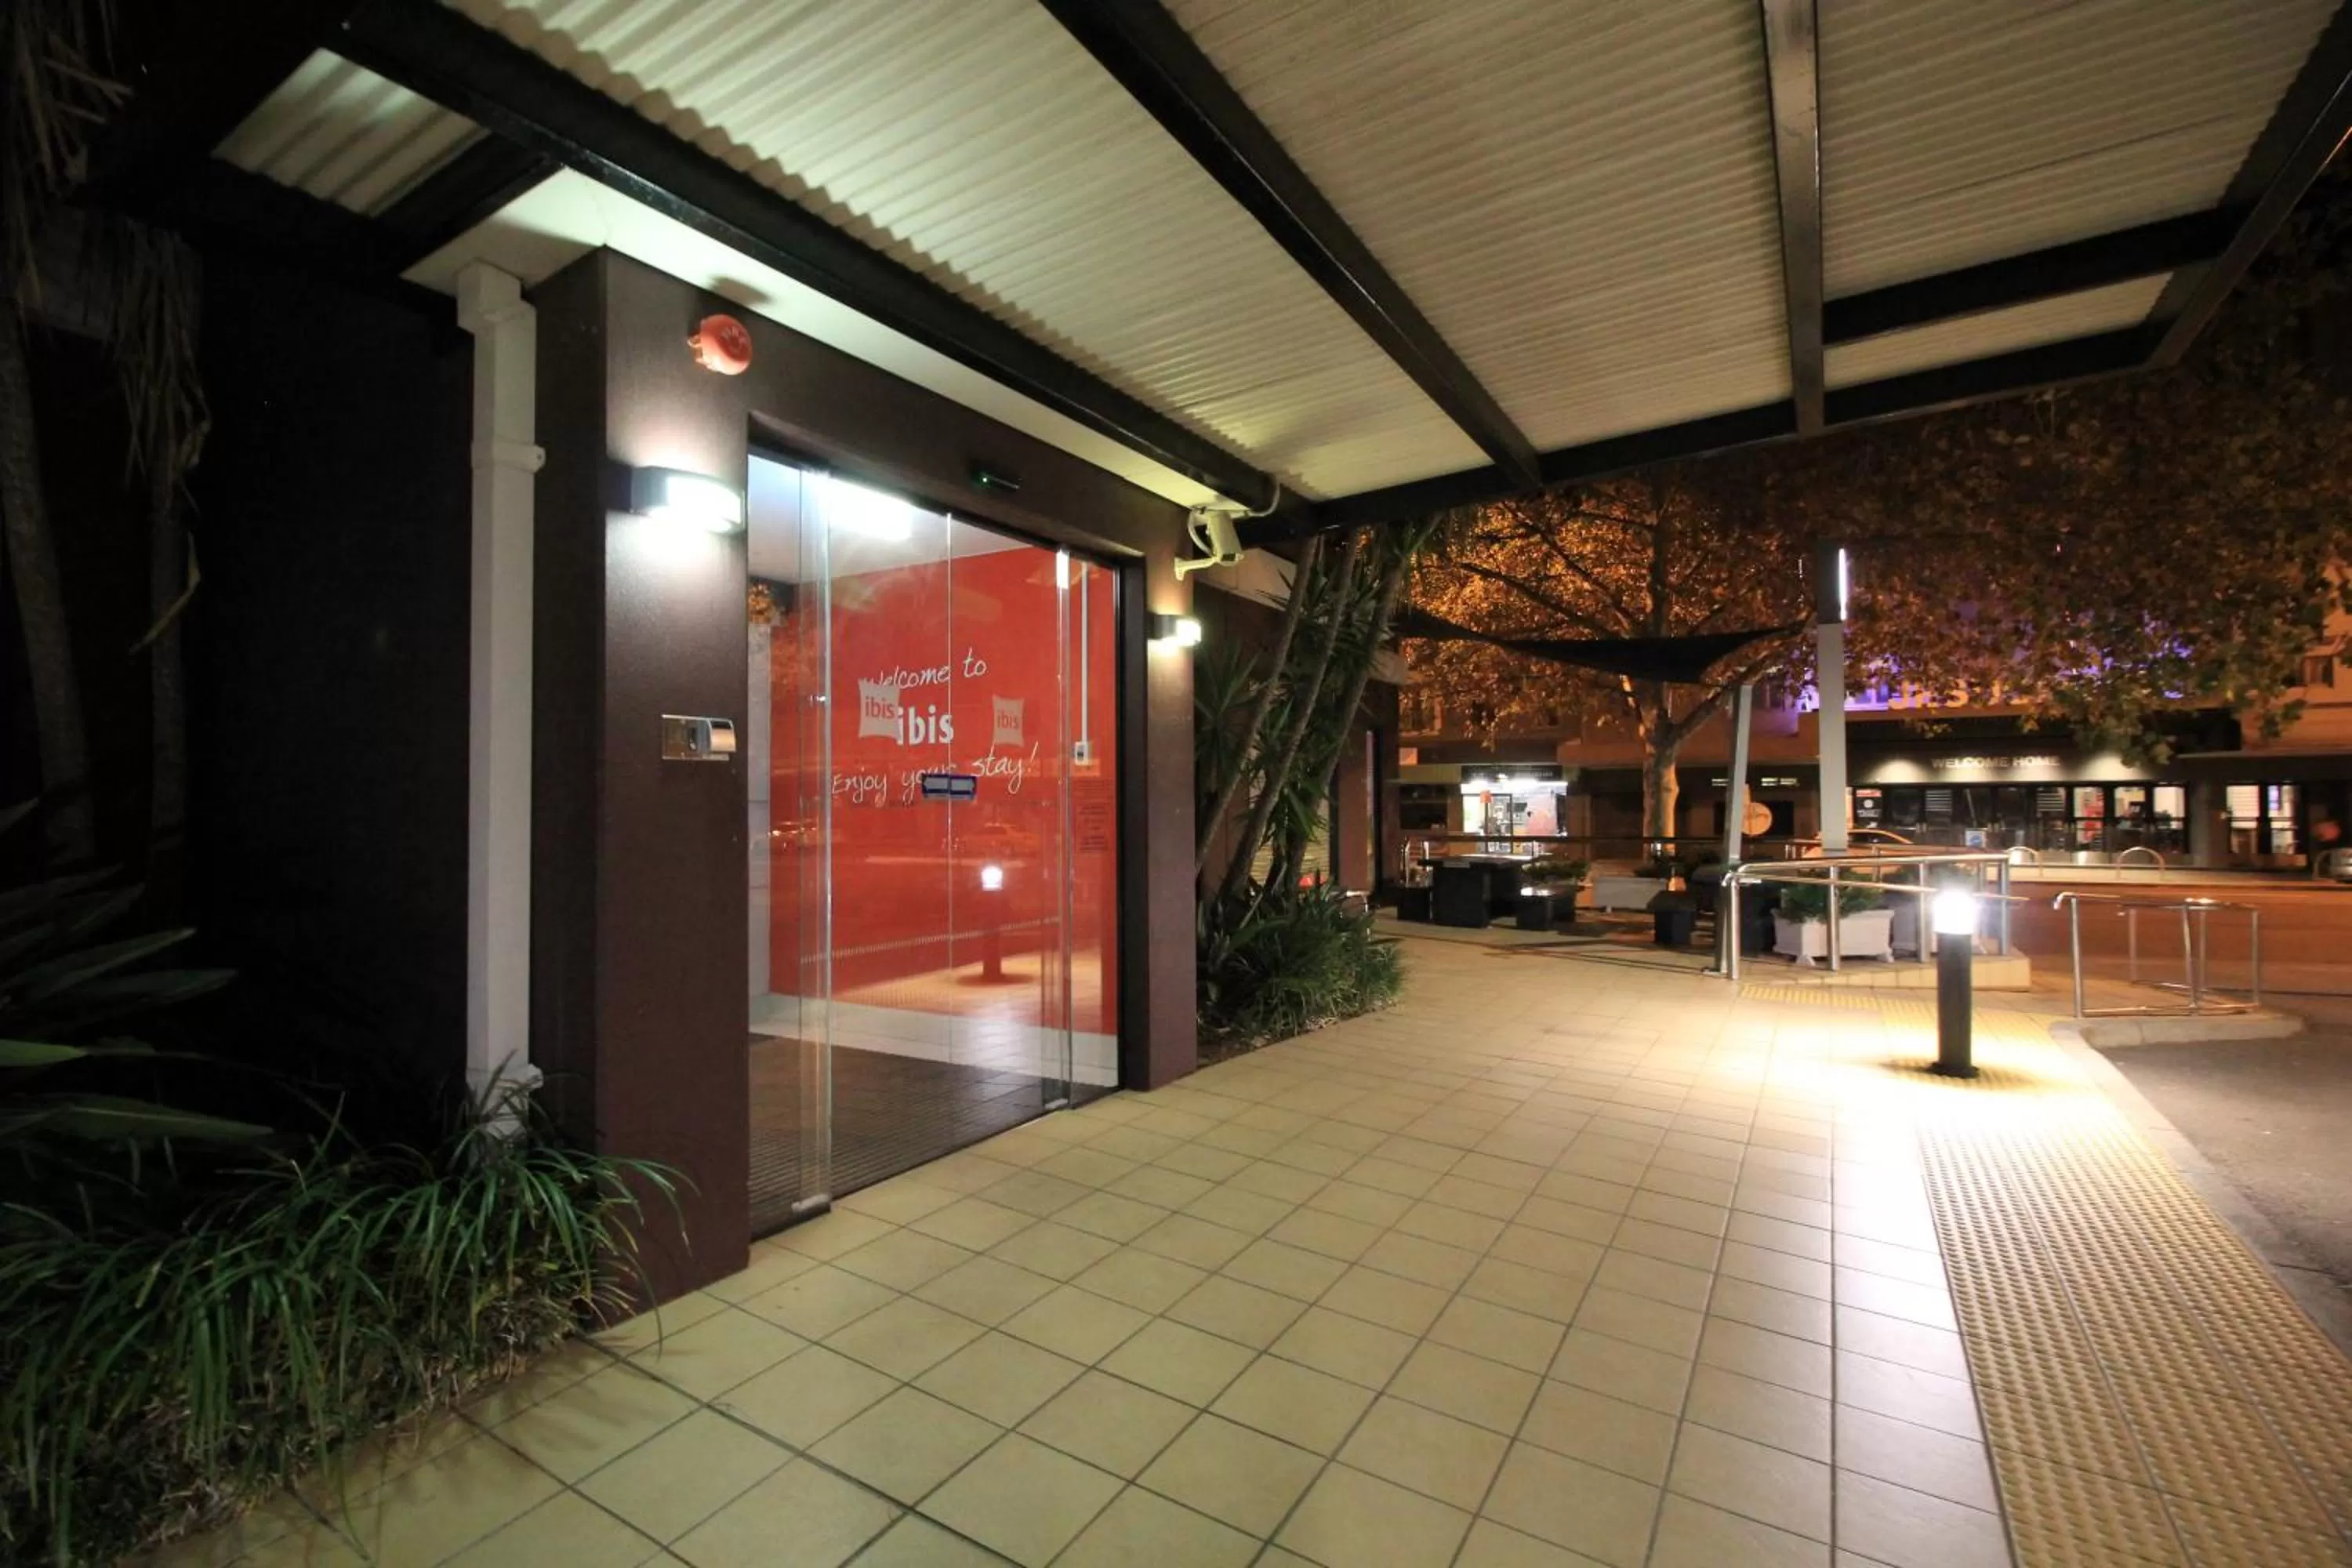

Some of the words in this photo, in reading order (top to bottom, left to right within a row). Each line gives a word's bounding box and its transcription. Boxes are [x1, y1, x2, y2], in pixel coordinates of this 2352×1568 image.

[963, 647, 987, 678] to
[865, 696, 895, 719] ibis
[996, 710, 1018, 729] ibis
[896, 705, 954, 746] ibis
[832, 767, 887, 804] Enjoy
[972, 741, 1039, 793] stay!
[1932, 757, 2011, 769] WELCOME
[2013, 755, 2060, 767] HOME
